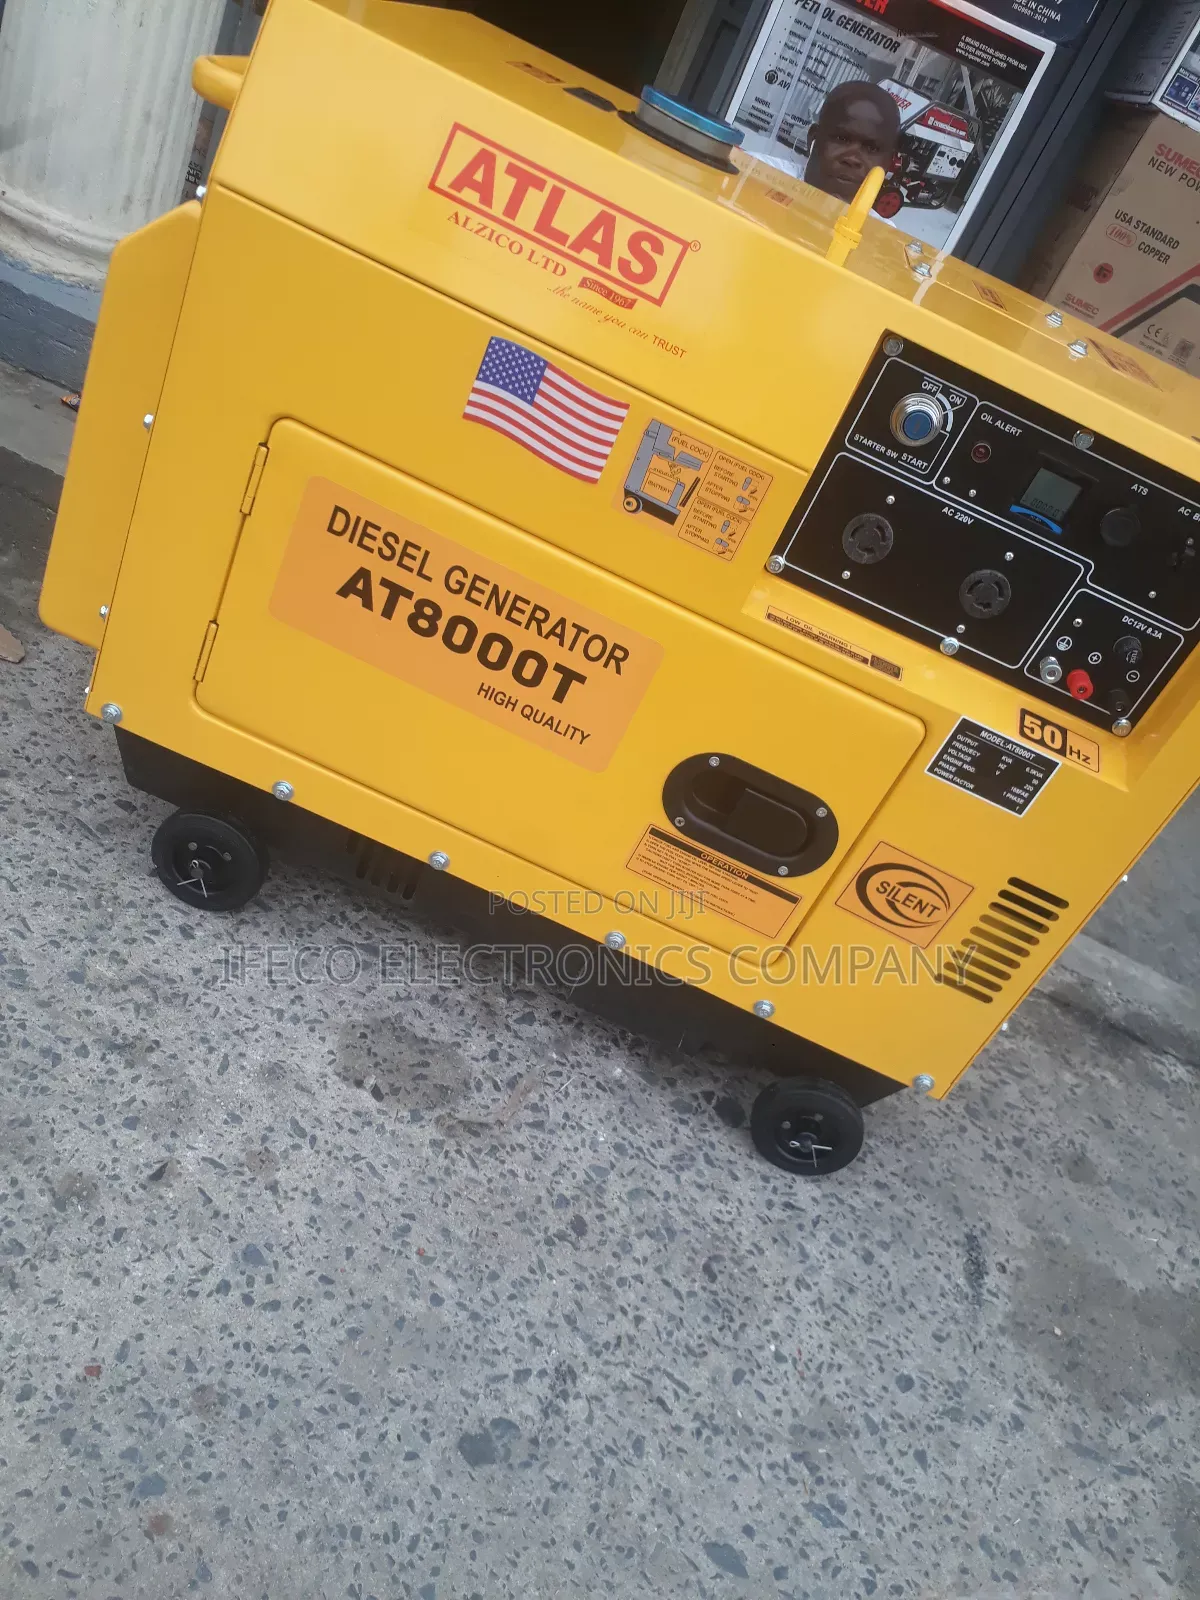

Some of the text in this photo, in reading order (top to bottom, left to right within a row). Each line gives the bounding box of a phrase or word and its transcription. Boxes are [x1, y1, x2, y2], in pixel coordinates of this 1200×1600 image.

[1028, 1, 1037, 10] IN
[1037, 5, 1061, 22] CHINA
[836, 14, 901, 54] GENERATOR
[1018, 62, 1028, 71] USA
[1148, 155, 1178, 177] NEW
[448, 148, 665, 285] ATLAS
[1114, 208, 1180, 251] USA STANDARD
[447, 210, 568, 278] ALZICO LTD
[1137, 240, 1171, 265] COPPER
[584, 278, 633, 308] Since 1967
[1065, 293, 1100, 315] SUMEC
[571, 295, 603, 315] name
[598, 310, 627, 329] you
[628, 325, 650, 340] can
[651, 334, 688, 359] TRUST
[922, 380, 939, 393] OFF
[949, 394, 962, 405] ON
[980, 412, 1023, 437] OIL ALERT
[671, 435, 688, 450] (FUEL
[854, 433, 899, 460] STARTER SW
[901, 452, 929, 471] START
[1130, 483, 1149, 496] ATS
[942, 505, 975, 526] AC 220V
[1177, 505, 1192, 516] AC
[326, 504, 631, 676] DIESEL GENERATOR
[335, 566, 588, 705] AT8000T
[785, 615, 802, 626] LOW
[803, 623, 814, 632] OIL
[1121, 615, 1163, 640] DC12V 8.3A
[476, 681, 592, 746] HIGH QUALITY
[1023, 713, 1064, 751] 50
[942, 754, 963, 769] ENGINE
[952, 741, 981, 757] FREQUECY
[998, 761, 1008, 771] HZ
[956, 734, 979, 748] OUTPUT
[1001, 755, 1013, 764] KVA
[933, 767, 953, 781] POWER
[953, 775, 975, 791] FACTOR
[938, 761, 956, 773] PHASE
[1006, 792, 1025, 805] PHASE
[947, 748, 972, 763] VOLTAGE
[1023, 783, 1034, 792] 220
[700, 852, 749, 880] OPERATION
[875, 880, 941, 918] SILENT
